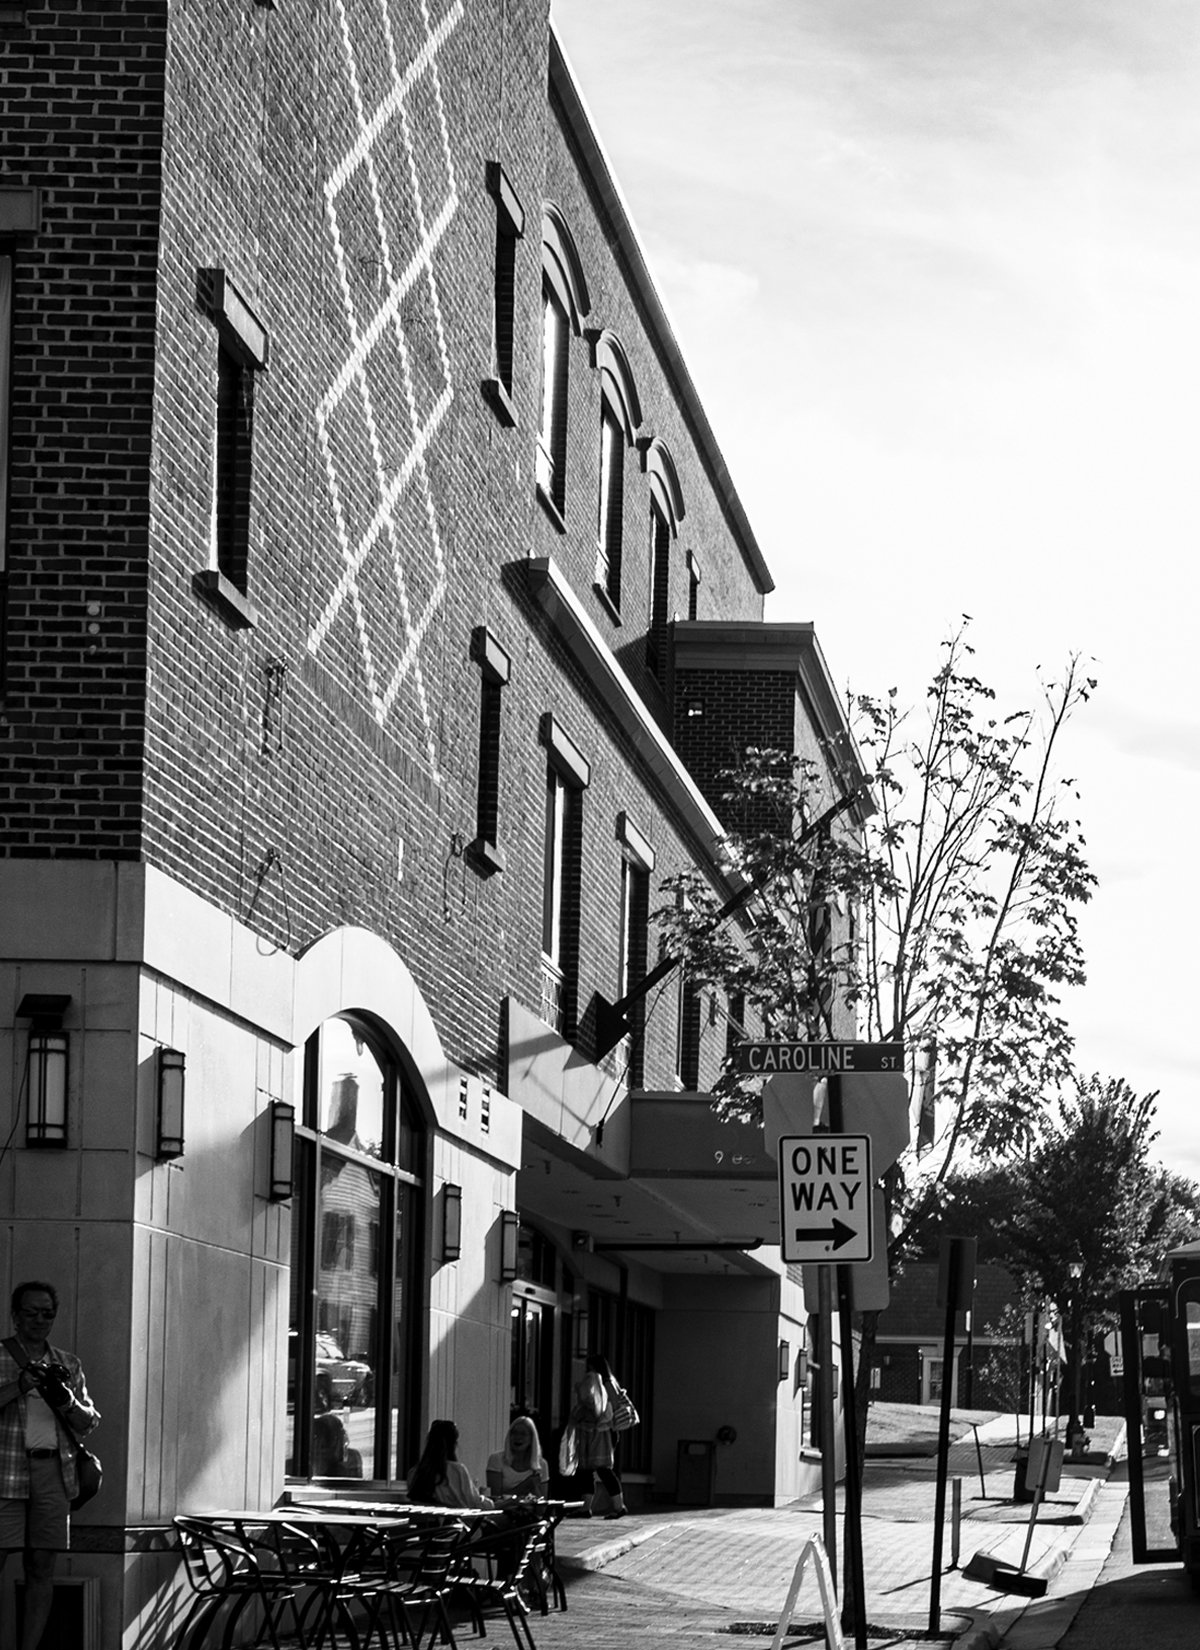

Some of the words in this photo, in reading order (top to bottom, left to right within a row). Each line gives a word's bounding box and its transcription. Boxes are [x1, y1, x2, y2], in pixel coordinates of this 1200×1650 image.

[748, 1046, 855, 1071] CAROLINE
[791, 1146, 859, 1176] ONE
[790, 1181, 862, 1211] WAY
